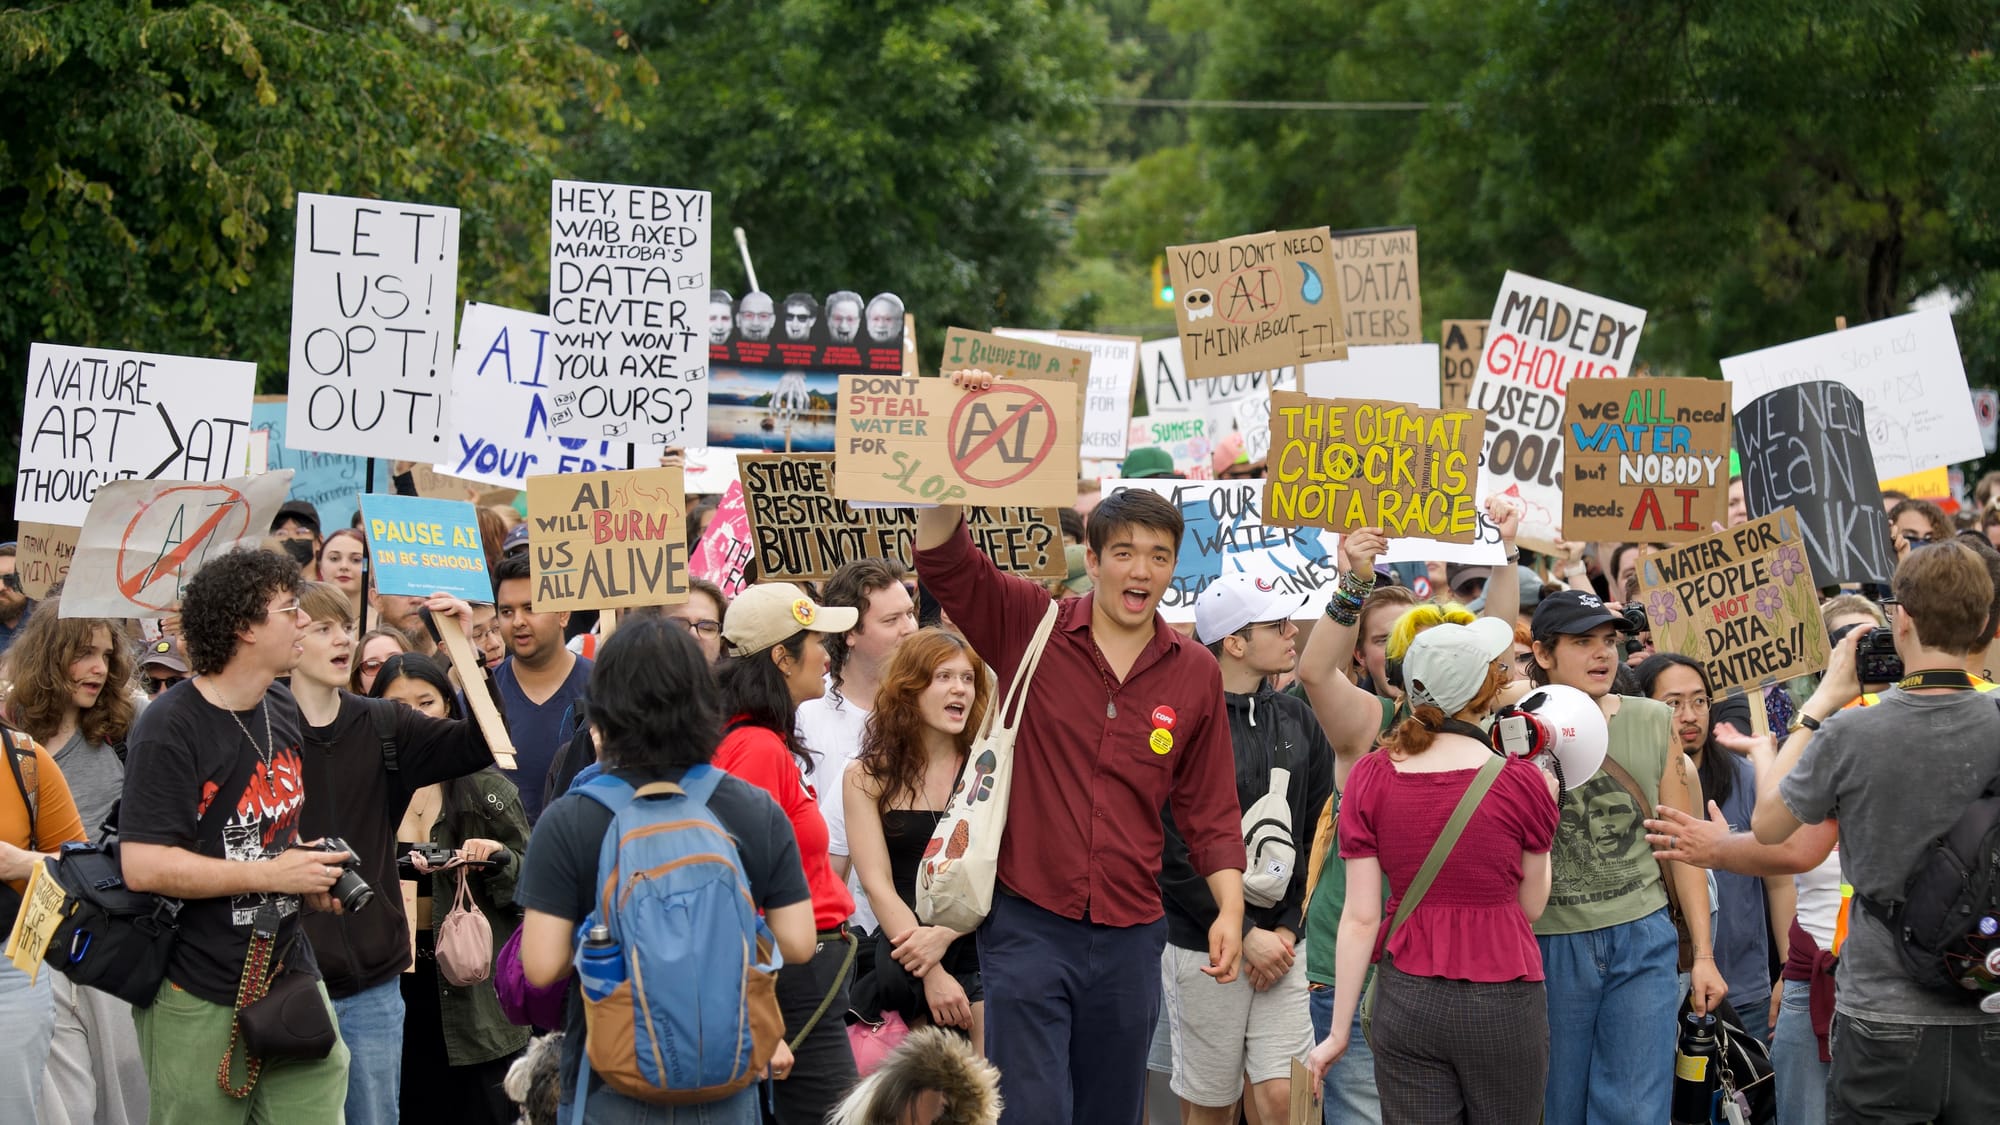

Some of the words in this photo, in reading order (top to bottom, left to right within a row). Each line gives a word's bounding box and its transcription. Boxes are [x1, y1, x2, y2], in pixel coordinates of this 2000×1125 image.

[558, 186, 617, 219] HEY,
[629, 189, 704, 222] EBY!
[309, 203, 448, 265] LET!
[553, 241, 684, 263] MANITOBA'S
[556, 218, 621, 244] WAB
[631, 223, 698, 248] AXED
[1178, 249, 1220, 284] YOU
[1282, 235, 1325, 257] NEED
[336, 271, 434, 320] US!
[558, 261, 672, 297] DATA
[1226, 268, 1276, 320] AI
[1342, 260, 1412, 304] DATA
[553, 297, 692, 332] CENTER,
[1345, 309, 1410, 339] TERS
[1500, 288, 1595, 352] MADE
[1590, 312, 1639, 361] BY
[304, 324, 441, 378] OPT!
[554, 330, 613, 351] WHY
[620, 330, 699, 353] WON'T
[950, 336, 968, 364] I
[1016, 349, 1042, 371] IN
[1045, 358, 1061, 374] A
[1186, 328, 1251, 361] THINK
[1253, 312, 1301, 343] ABOUT
[1297, 317, 1337, 359] IT!
[35, 356, 157, 406] NATURE
[554, 353, 608, 381] YOU
[619, 354, 679, 380] AXE
[1088, 374, 1118, 391] PLE!
[850, 377, 920, 396] DON'T
[1090, 396, 1115, 412] FOR
[307, 383, 443, 444] OUT!
[578, 384, 693, 433] OURS?
[849, 395, 930, 418] STEAL
[1278, 403, 1349, 441] THE
[1478, 381, 1564, 431] USED
[1622, 388, 1676, 425] ALL
[1676, 402, 1727, 425] need
[1738, 391, 1788, 459] WE
[1796, 379, 1863, 438] NEED
[31, 404, 136, 463] ART
[850, 417, 928, 437] WATER
[955, 402, 1044, 464] AI
[850, 437, 888, 455] FOR
[1151, 418, 1206, 445] SUMMER
[1483, 418, 1564, 487] OOL
[1574, 462, 1608, 482] but
[1618, 452, 1724, 487] NOBODY
[746, 460, 826, 493] STAGE
[881, 450, 968, 504] SLOP
[570, 480, 611, 513] AI
[1208, 485, 1261, 522] OUR
[1271, 481, 1350, 525] NOT
[1344, 488, 1369, 530] A
[1377, 489, 1477, 537] RACE
[1572, 499, 1625, 519] needs
[1628, 487, 1706, 532] A.I.
[370, 518, 446, 547] PAUSE
[452, 525, 479, 550] AI
[535, 513, 589, 534] WILL
[593, 509, 668, 545] BURN
[1191, 522, 1309, 557] WATER
[377, 549, 397, 565] IN
[399, 550, 419, 567] BC
[421, 552, 484, 573] SCHOOLS
[536, 540, 574, 570] US
[755, 525, 813, 575] BUT
[814, 526, 868, 573] NOT
[877, 528, 917, 572] FO
[1655, 538, 1733, 584] WATER
[1732, 522, 1782, 557] FOR
[536, 573, 575, 603] ALL
[577, 542, 688, 600] ALIVE
[1676, 557, 1770, 617] PEOPLE
[1711, 593, 1750, 624] NOT
[1705, 614, 1769, 657] DATA
[1699, 622, 1805, 692] ENTRES!!
